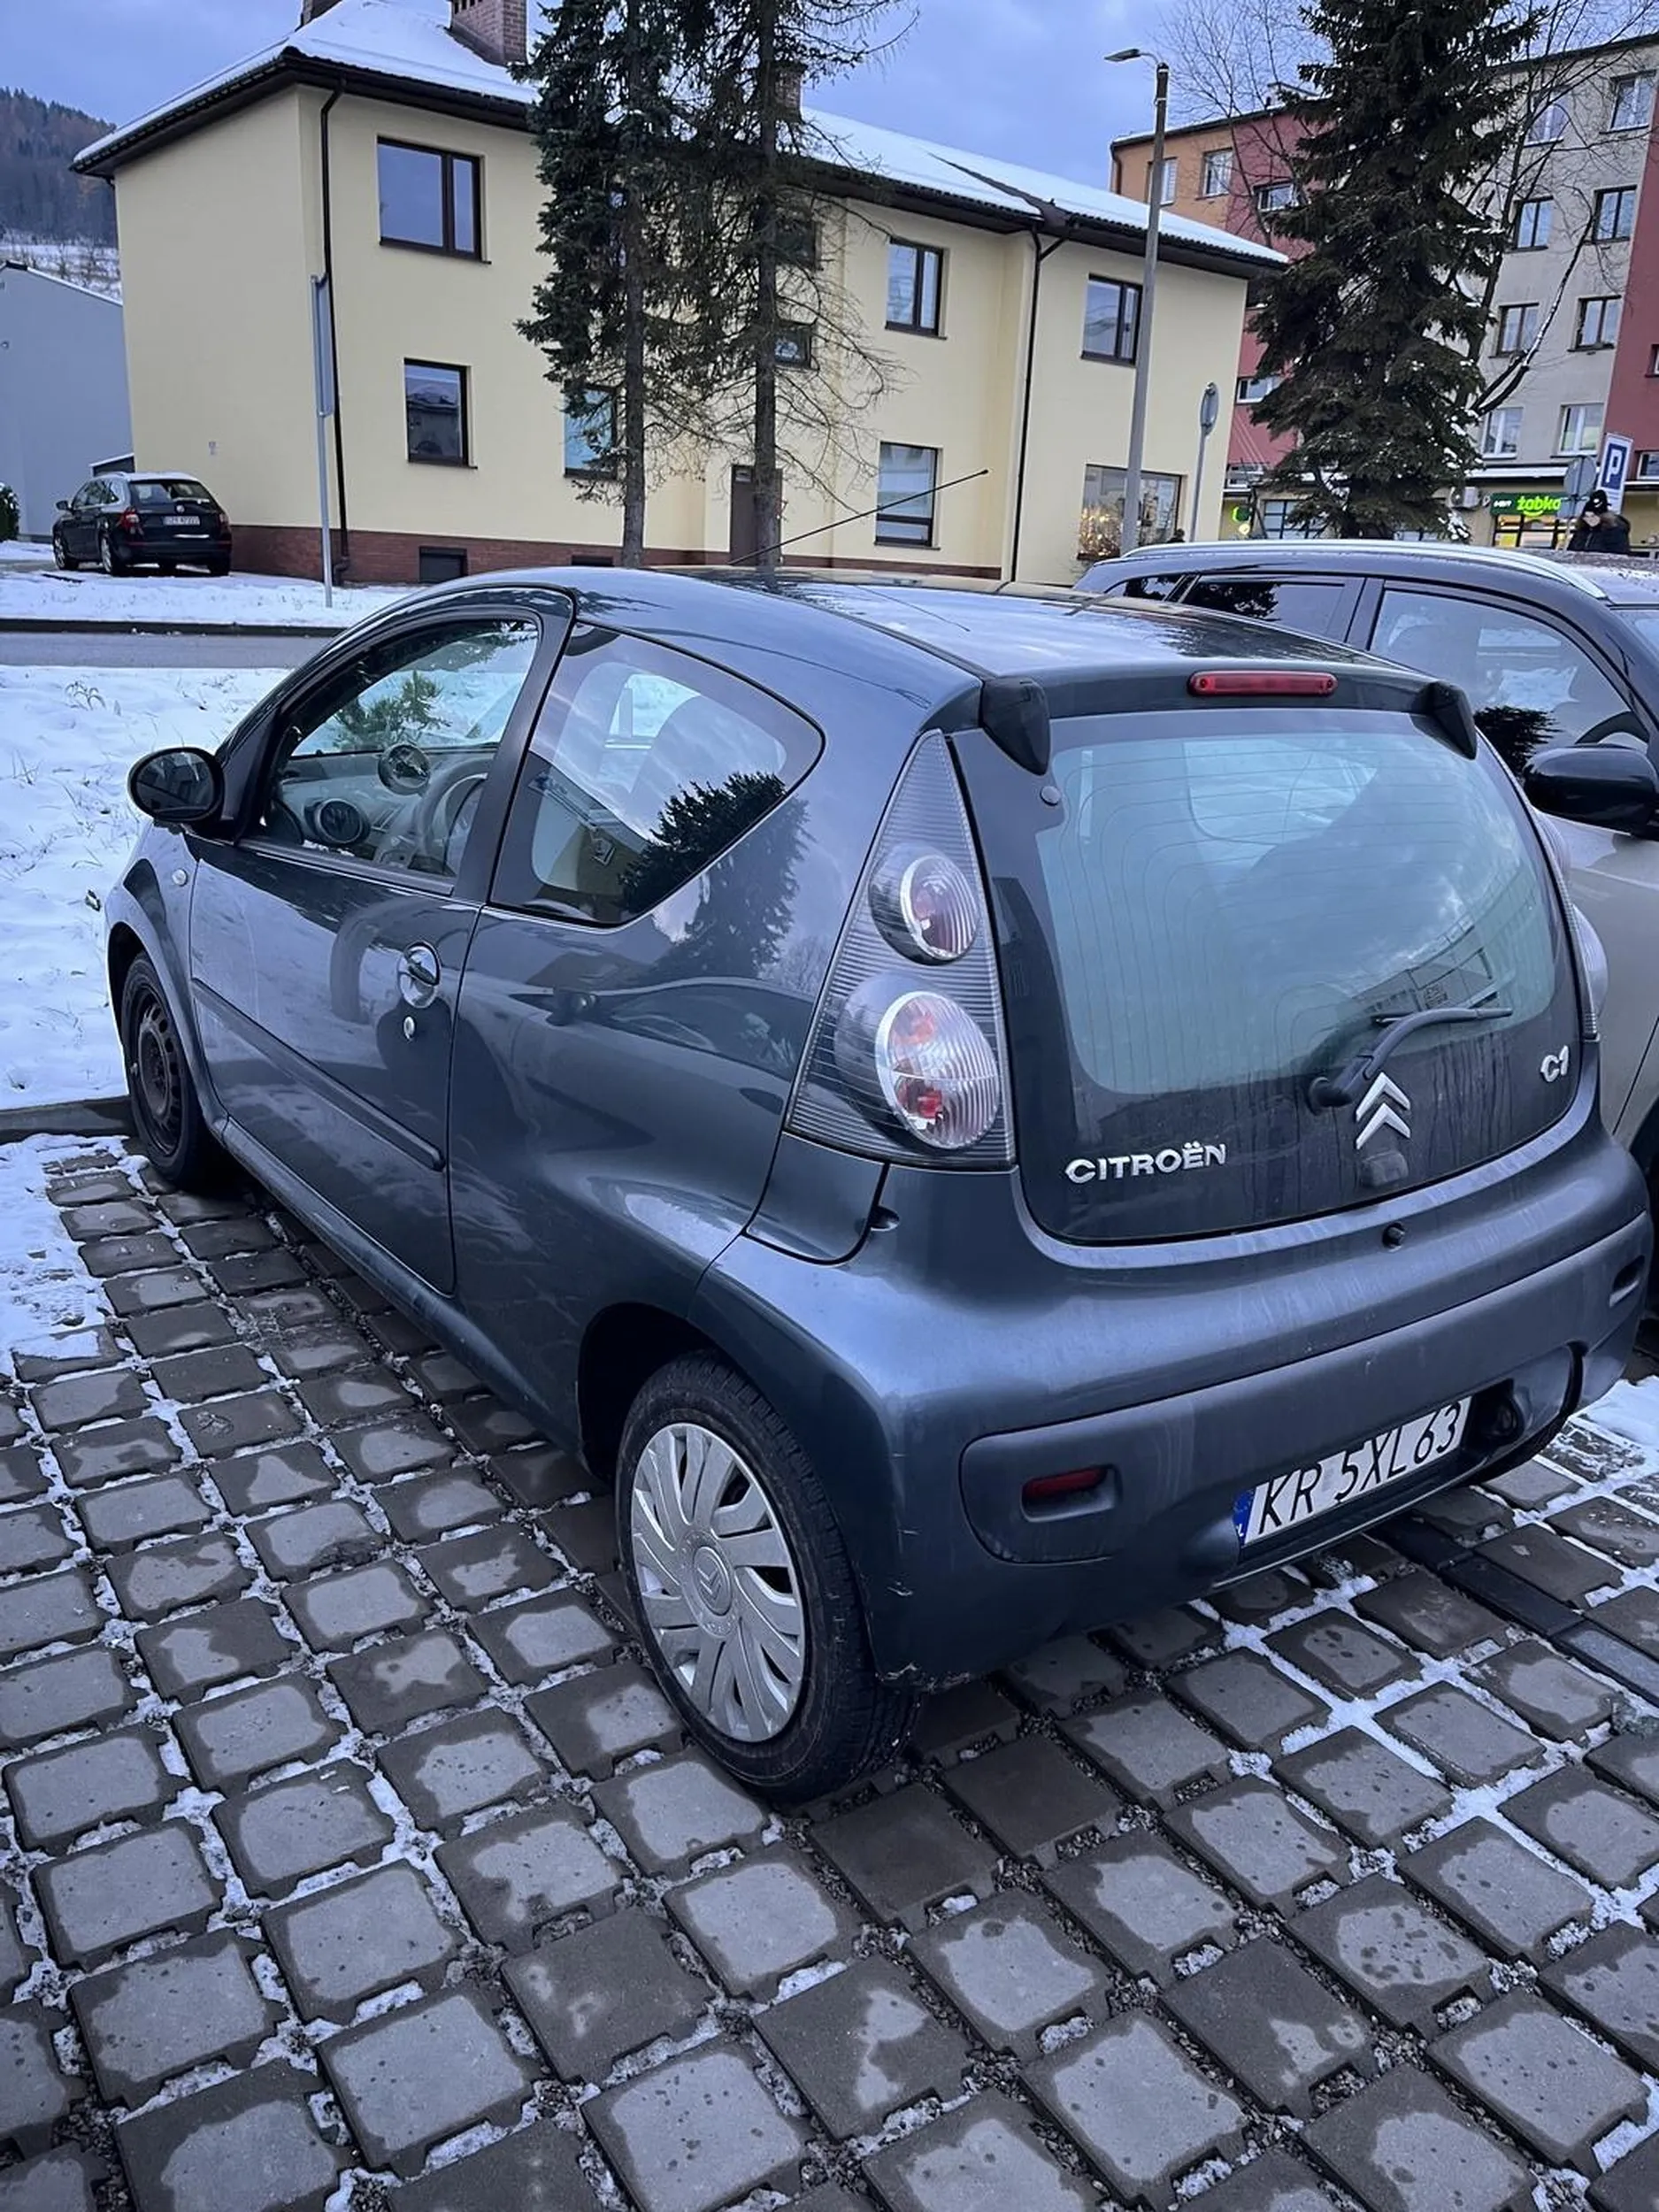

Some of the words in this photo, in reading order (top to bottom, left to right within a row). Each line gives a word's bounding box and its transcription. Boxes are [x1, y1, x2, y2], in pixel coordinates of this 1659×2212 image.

[1605, 449, 1623, 483] P
[1540, 1045, 1569, 1082] C1
[1064, 1141, 1226, 1184] CITROËN
[1259, 1463, 1323, 1535] KR
[1334, 1401, 1462, 1502] 5XL63
